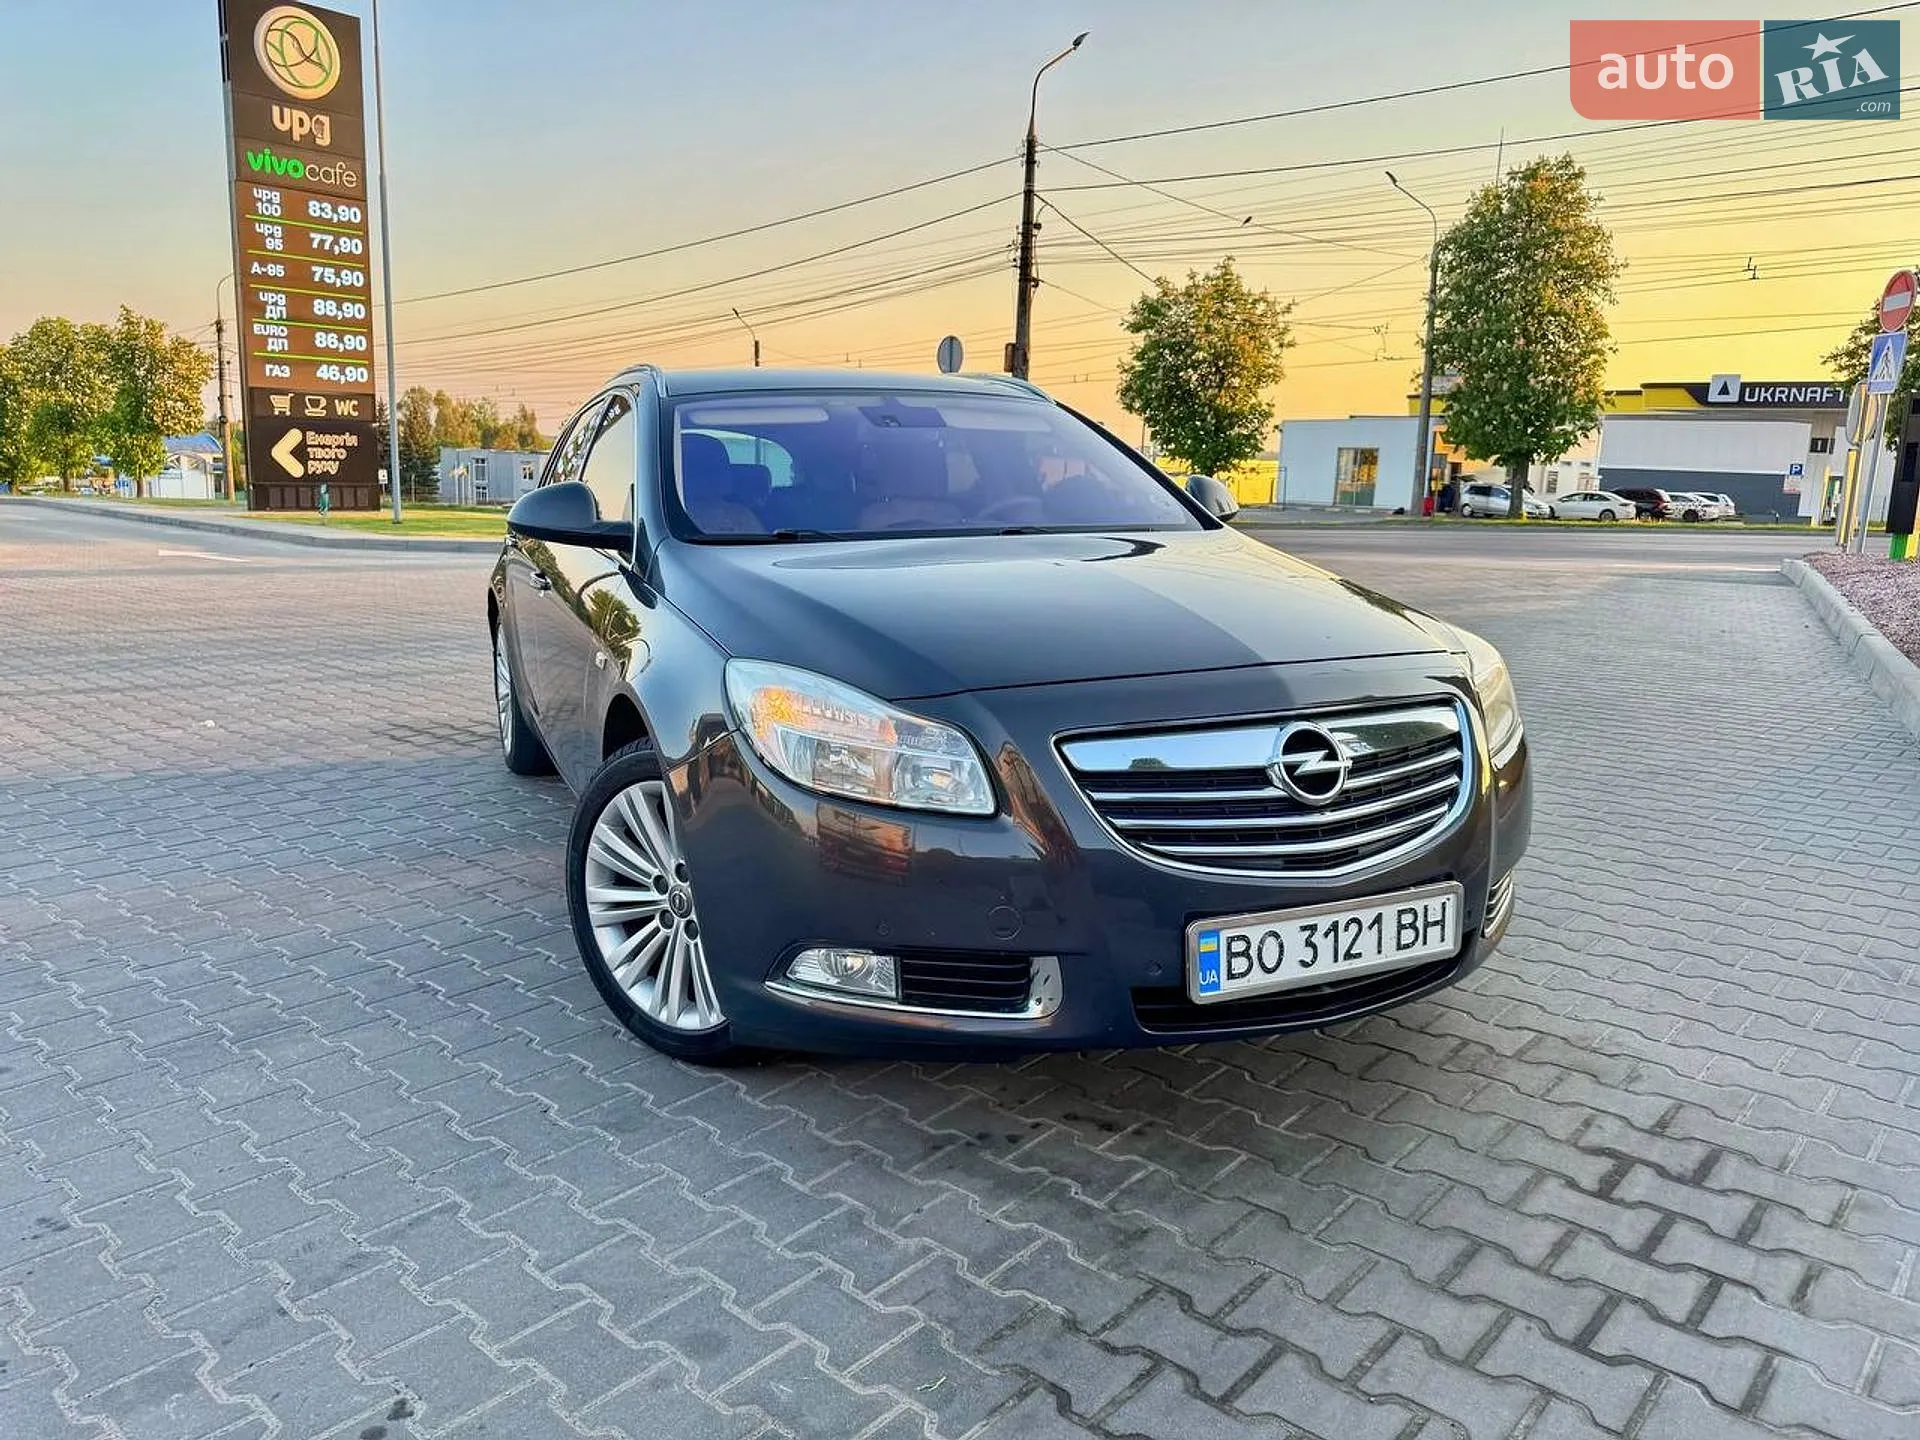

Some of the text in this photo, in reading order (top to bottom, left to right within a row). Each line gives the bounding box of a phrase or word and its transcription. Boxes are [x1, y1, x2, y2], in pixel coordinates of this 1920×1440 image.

[271, 104, 331, 147] upg
[253, 187, 281, 203] upg
[256, 200, 362, 223] 100 83,90
[255, 222, 282, 238] upg
[265, 232, 363, 255] 95 77,90
[311, 265, 365, 287] 75,90
[259, 291, 286, 306] upg
[265, 299, 366, 320] ДП 88,90
[253, 323, 288, 337] EURO
[267, 331, 367, 352] ДП 86,90
[265, 363, 369, 384] ГАЗ 46,90
[334, 399, 359, 417] WC
[1298, 912, 1384, 968] 3121
[1199, 968, 1221, 986] UA
